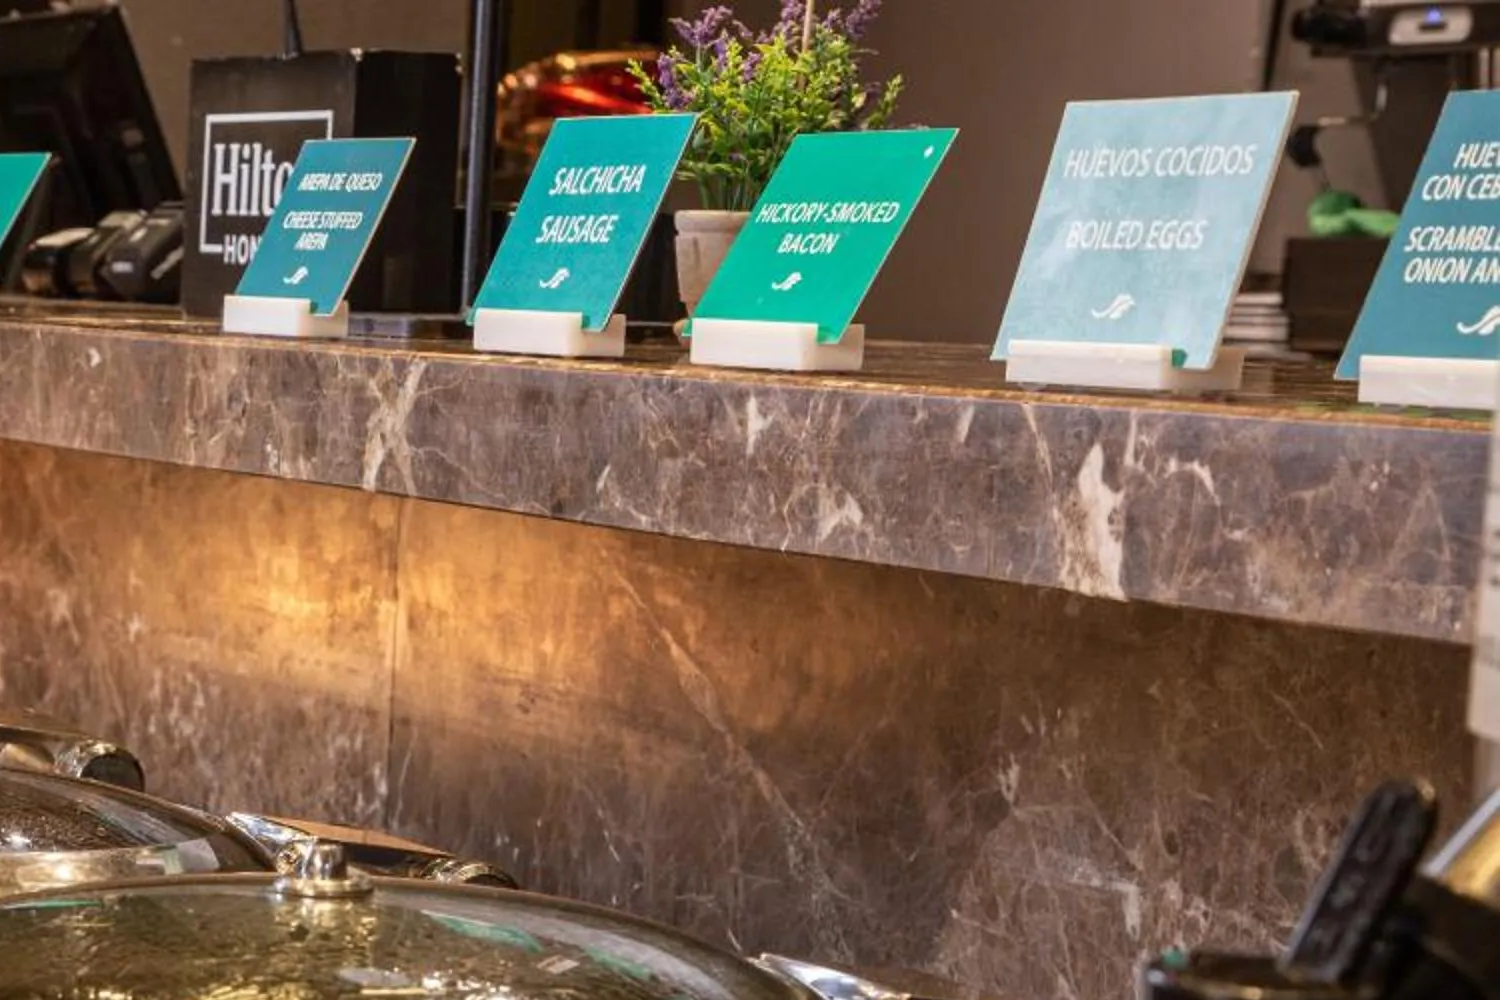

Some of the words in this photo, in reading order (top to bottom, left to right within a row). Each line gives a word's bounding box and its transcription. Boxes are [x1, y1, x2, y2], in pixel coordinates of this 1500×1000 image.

[1063, 147, 1152, 178] HUEVOS
[1153, 144, 1259, 177] COCIDOS
[345, 173, 383, 193] QUESO
[548, 164, 647, 195] SALCHICHA
[1422, 174, 1467, 201] CON
[755, 201, 901, 224] HICKORY-SMOKED
[536, 214, 619, 243] SAUSAGE
[1065, 219, 1144, 250] BOILED
[1144, 218, 1211, 250] EGGS
[776, 232, 841, 255] BACON
[1404, 256, 1473, 283] ONION
